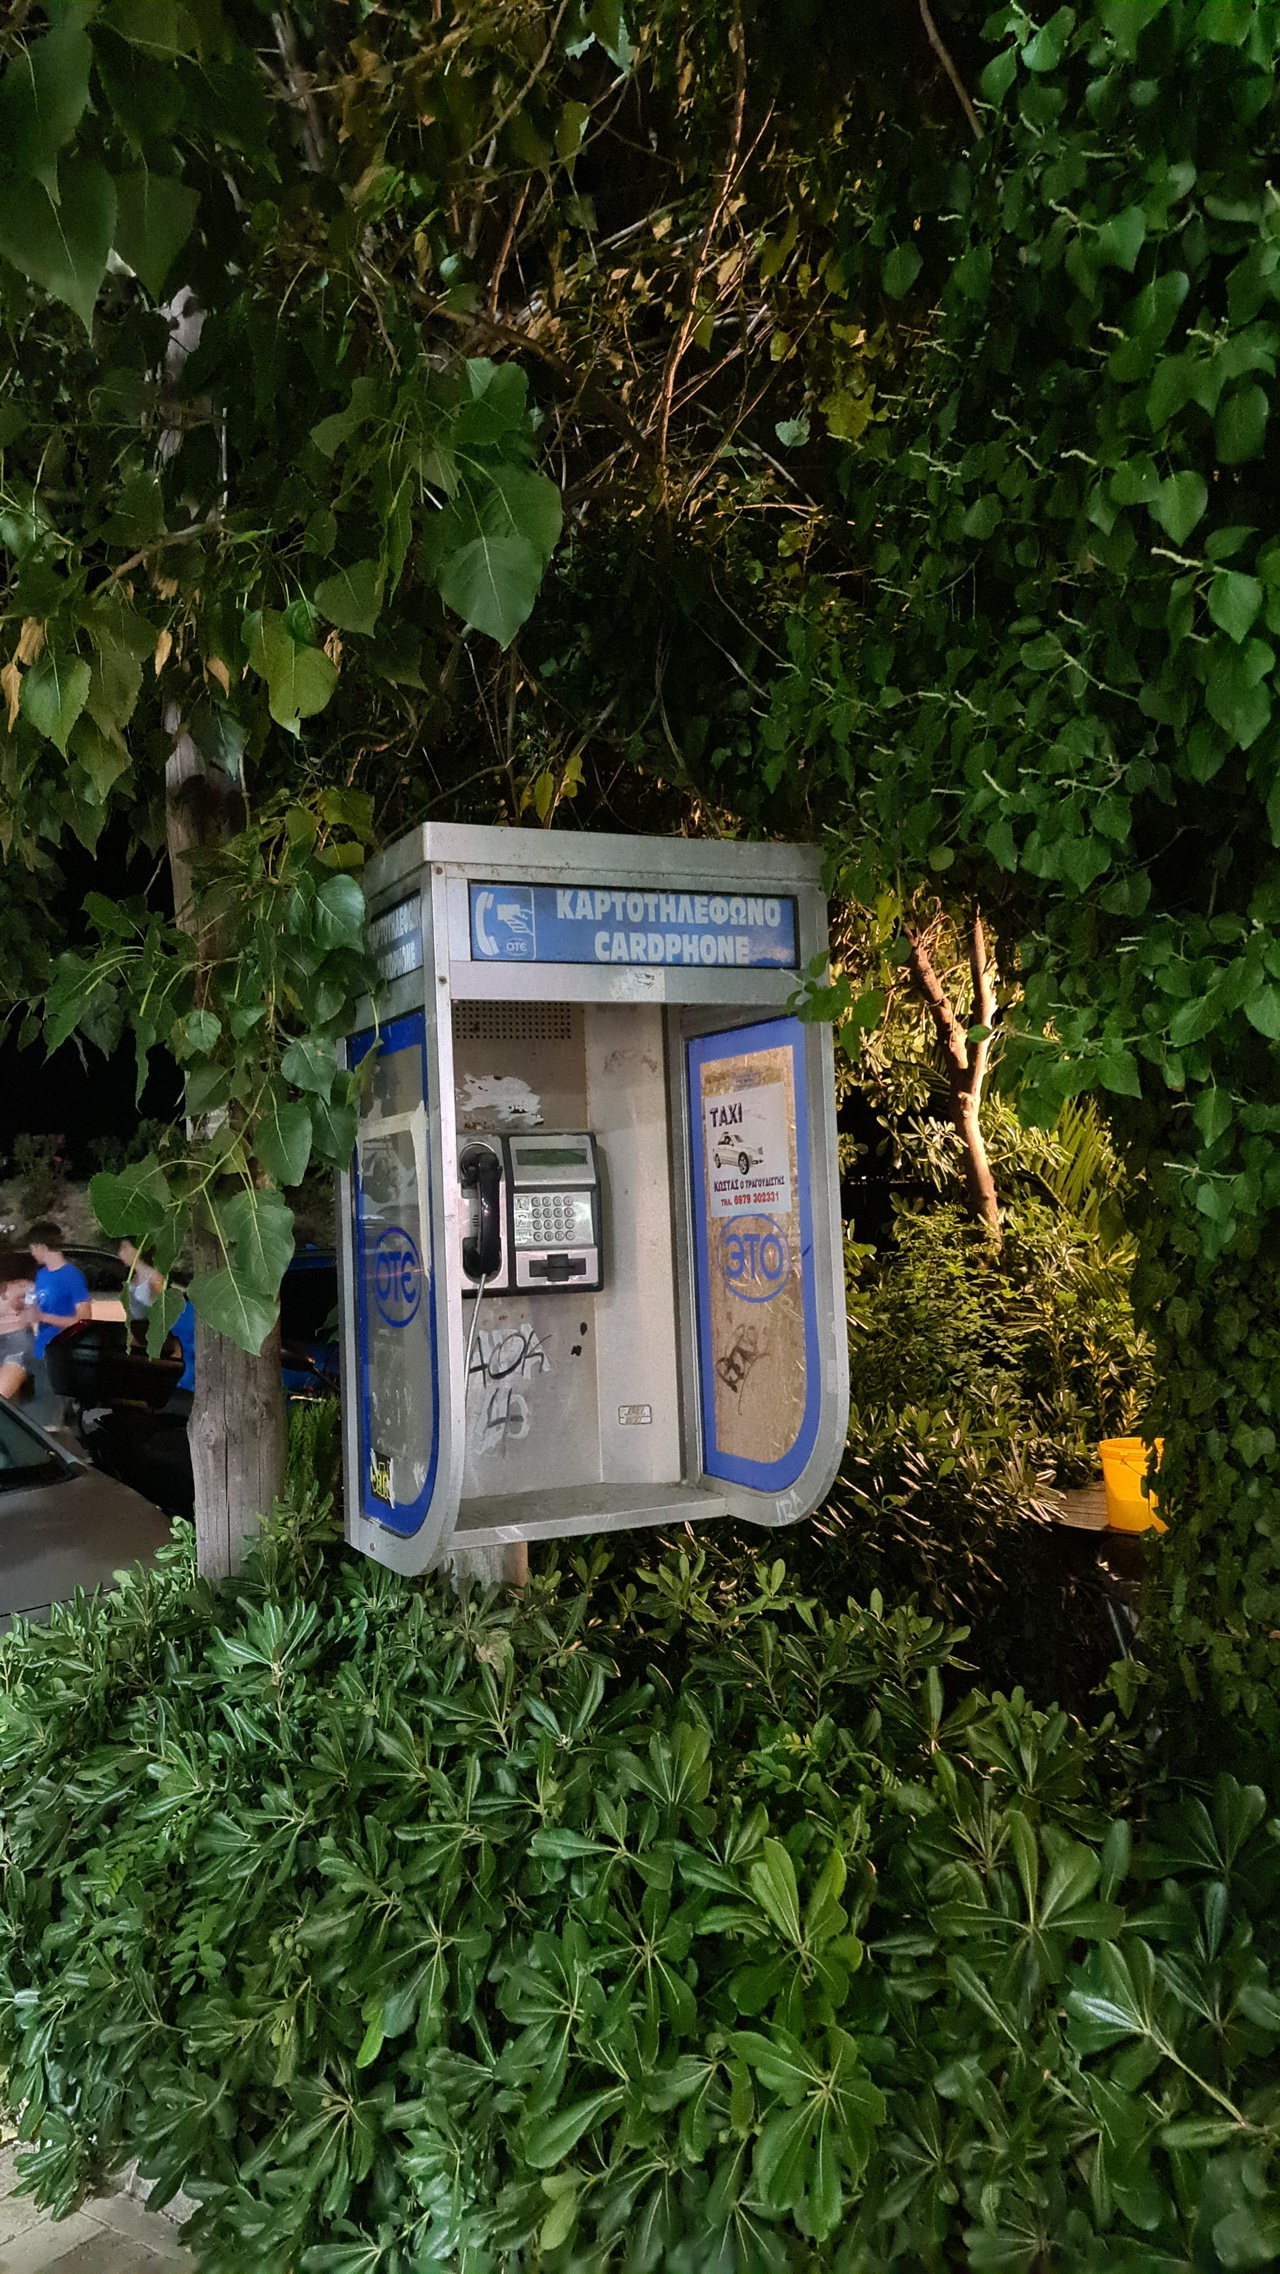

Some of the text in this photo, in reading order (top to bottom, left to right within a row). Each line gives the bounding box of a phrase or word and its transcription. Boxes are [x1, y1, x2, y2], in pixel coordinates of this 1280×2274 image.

[556, 889, 782, 928] ΚΑΡΤΟΤΗΛΕΦΩΝΟ
[594, 931, 751, 964] CARDPHONE
[709, 1102, 743, 1128] TAXI
